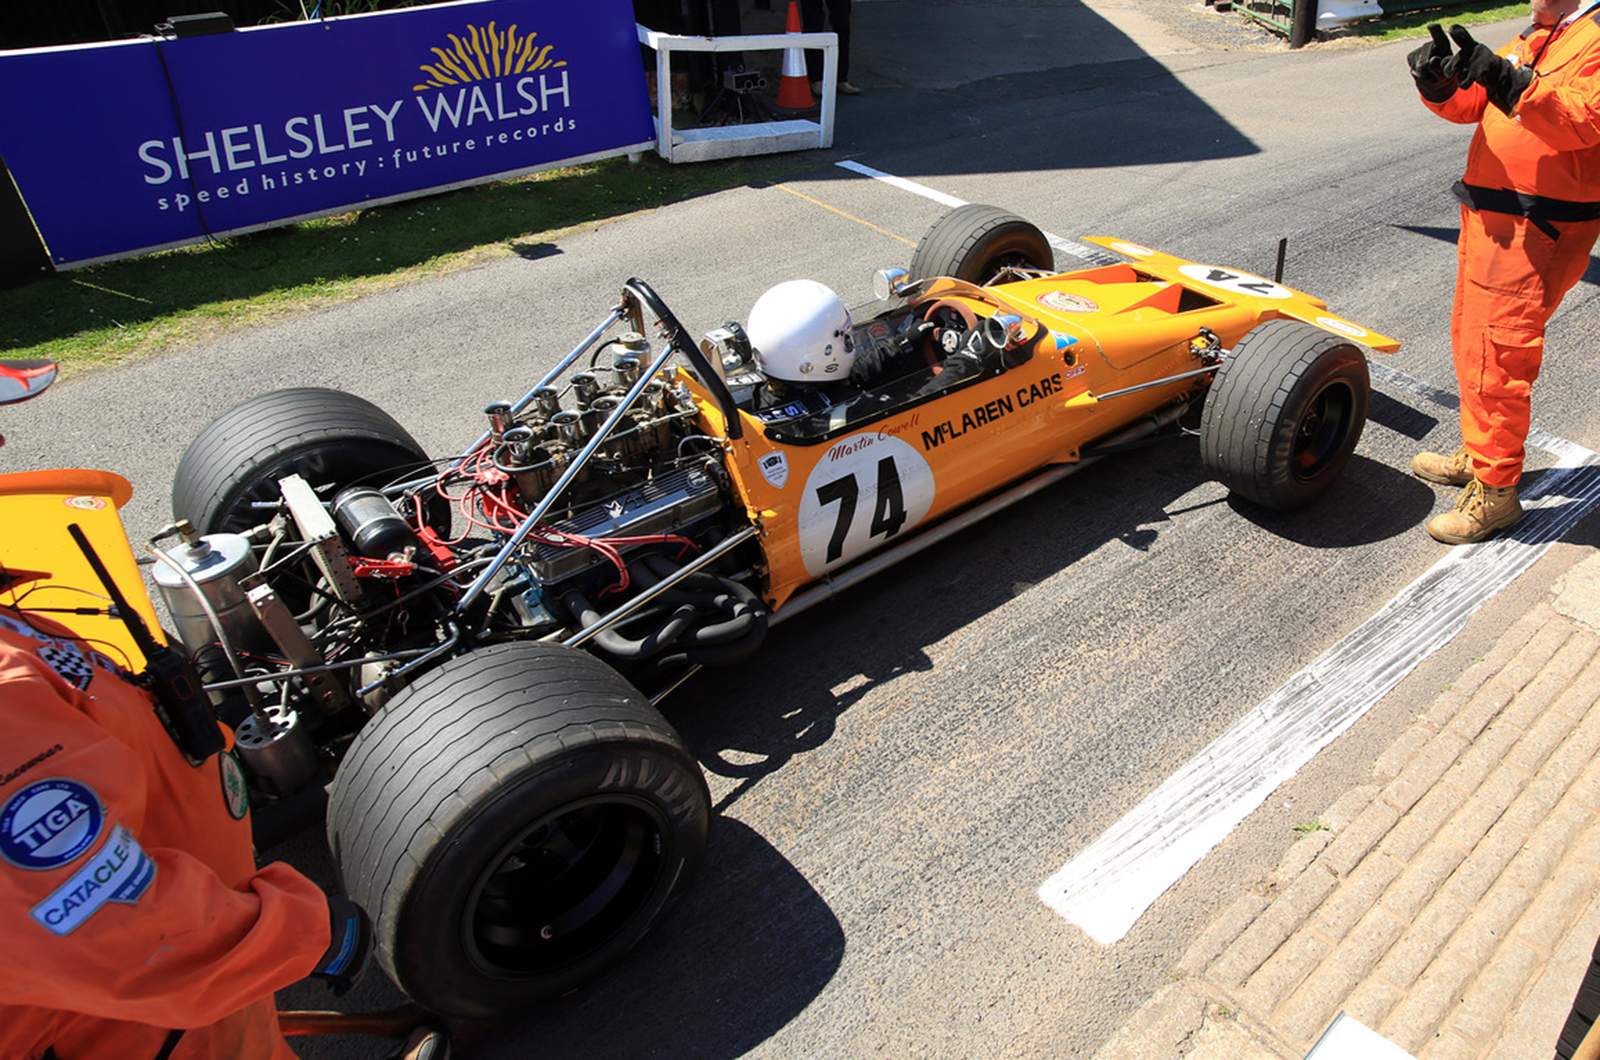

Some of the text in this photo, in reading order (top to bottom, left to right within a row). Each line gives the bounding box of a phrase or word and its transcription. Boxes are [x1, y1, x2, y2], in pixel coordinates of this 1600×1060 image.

[138, 70, 571, 185] SHELSLEY WALSH
[157, 178, 250, 212] speed
[261, 160, 367, 191] history
[392, 138, 476, 169] future
[485, 117, 577, 147] records
[1016, 373, 1064, 408] CARS
[828, 413, 920, 463] Martin Cowell
[816, 455, 908, 565] 74
[12, 798, 90, 850] TIGA
[597, 755, 699, 828] AVON
